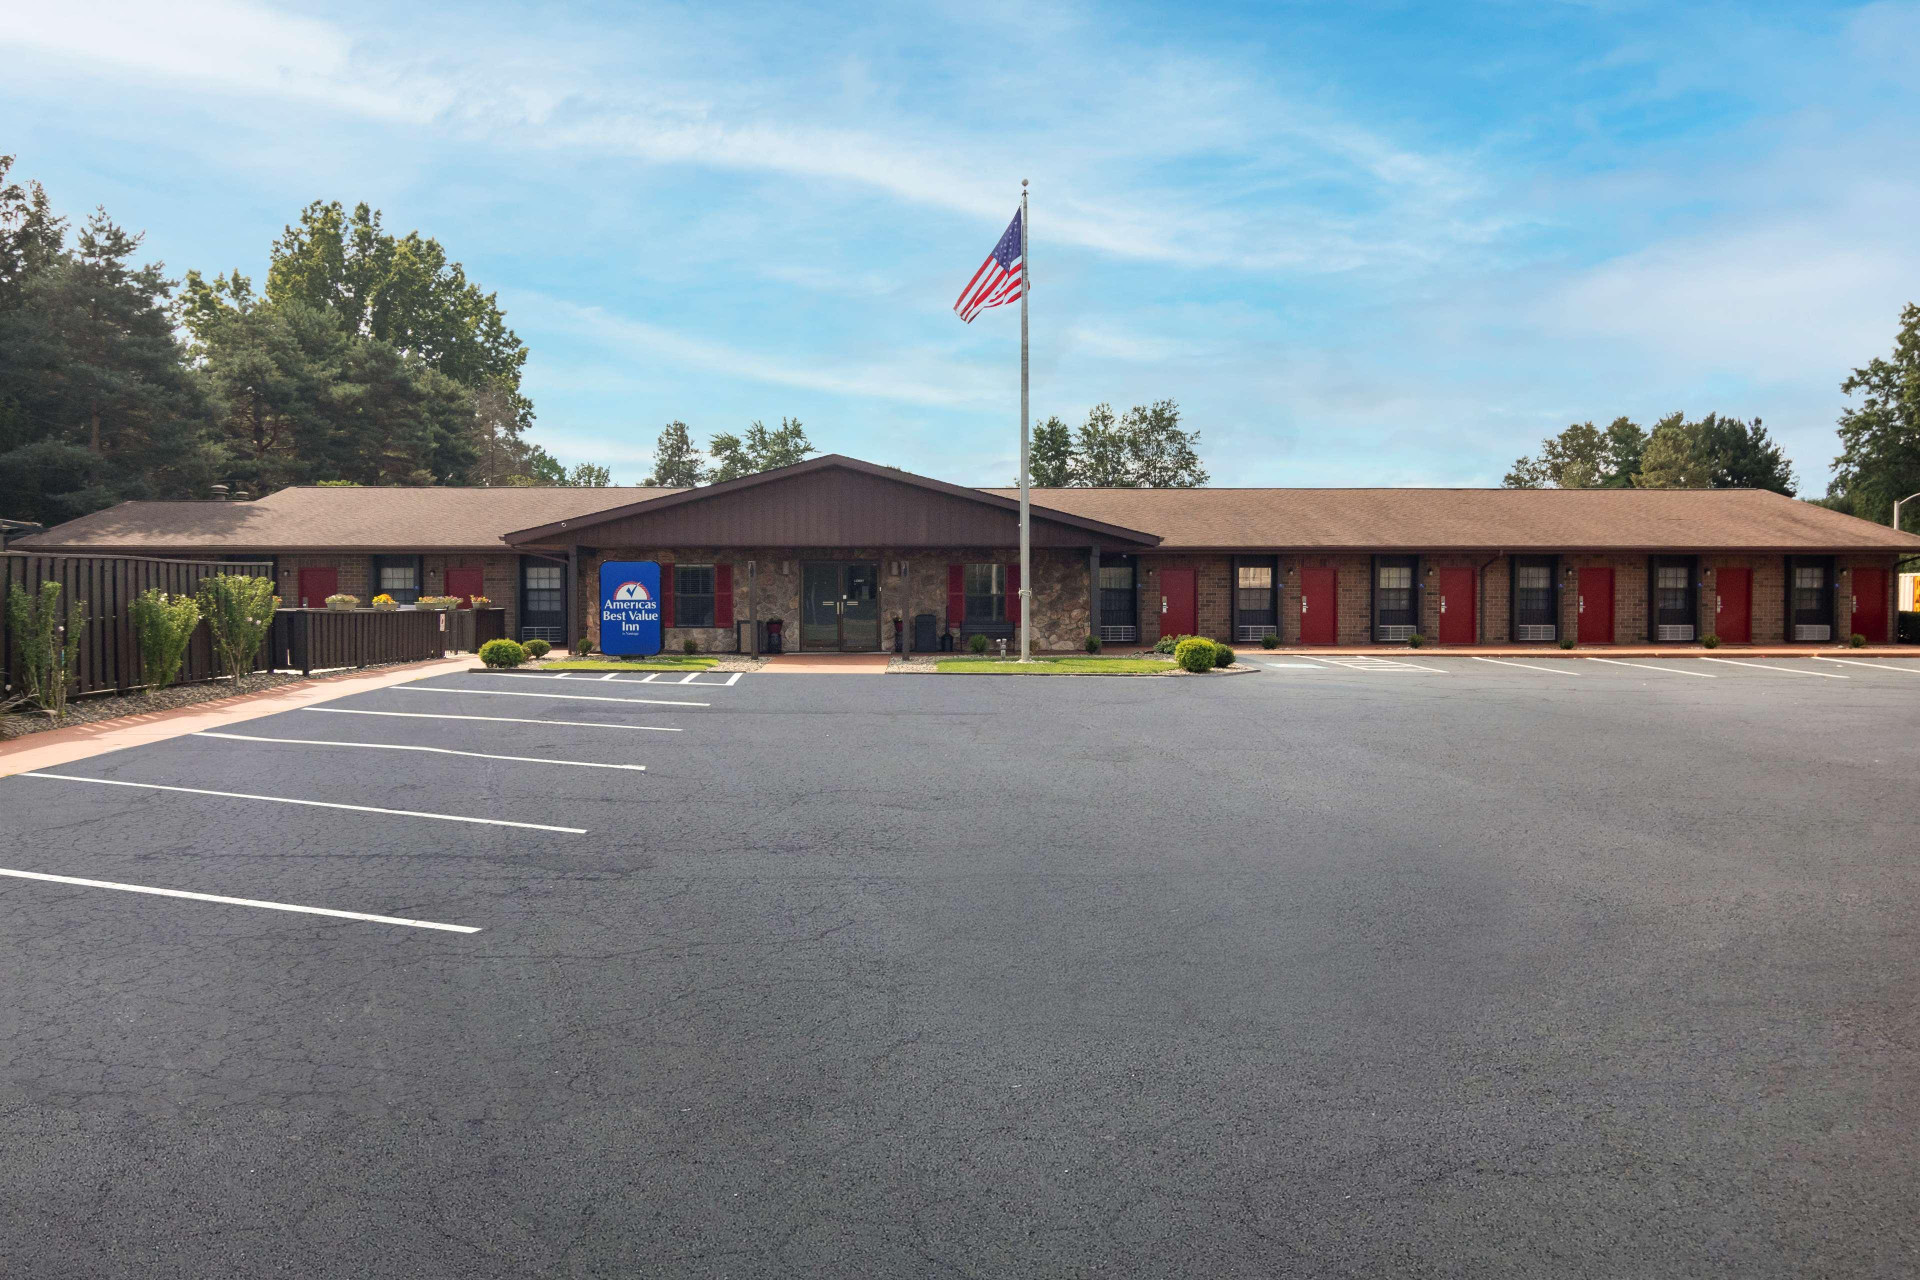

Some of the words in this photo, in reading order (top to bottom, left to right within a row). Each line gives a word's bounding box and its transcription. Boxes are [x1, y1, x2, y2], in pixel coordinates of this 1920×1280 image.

[604, 599, 657, 609] Americas
[603, 610, 626, 621] Best
[628, 610, 659, 621] Value
[622, 621, 640, 631] Inn
